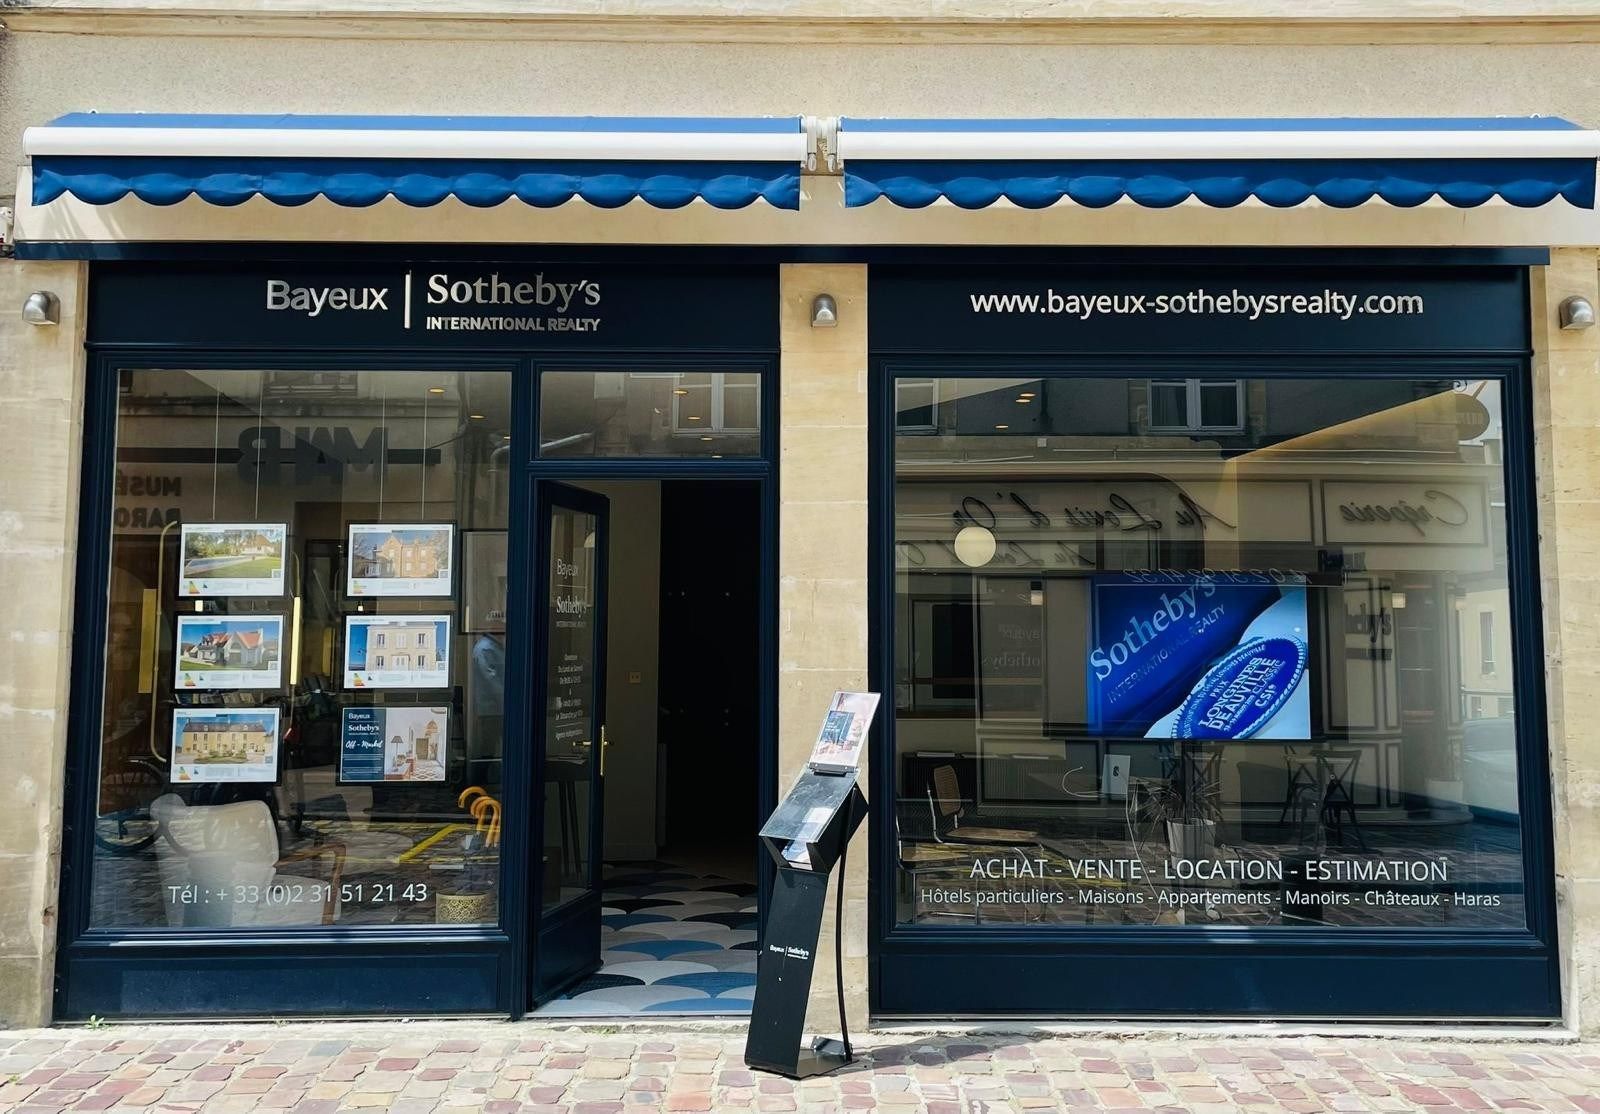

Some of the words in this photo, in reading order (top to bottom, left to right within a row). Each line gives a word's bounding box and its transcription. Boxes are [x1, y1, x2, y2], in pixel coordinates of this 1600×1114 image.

[266, 279, 389, 317] Bayeux
[427, 272, 601, 312] Sotheby's
[970, 288, 1424, 320] www.bayeux-sothebysrealty.com
[426, 316, 545, 331] INTERNATIONAL
[547, 317, 601, 332] REALTY
[1090, 577, 1217, 682] Sotheby's
[1198, 657, 1263, 728] LONGINES
[1207, 658, 1276, 731] DEAUVILLE
[969, 859, 1049, 879] ACHAT
[1068, 859, 1142, 879] VENTE
[1163, 859, 1283, 881] LOCATION
[1305, 860, 1448, 882] ESTIMATION
[167, 884, 198, 903] Tél
[234, 886, 259, 903] 33
[265, 885, 304, 906] (0)2
[309, 885, 333, 902] 31
[341, 884, 364, 901] 51
[371, 884, 394, 901] 21
[402, 884, 428, 901] 43
[921, 889, 971, 904] Hôtels
[976, 889, 1064, 907] particuliers
[1078, 889, 1144, 904] Maisons
[1157, 890, 1271, 907] Appartements
[1286, 890, 1351, 905] Manoirs
[1364, 890, 1440, 906] Châteaux
[1454, 891, 1501, 906] Haras
